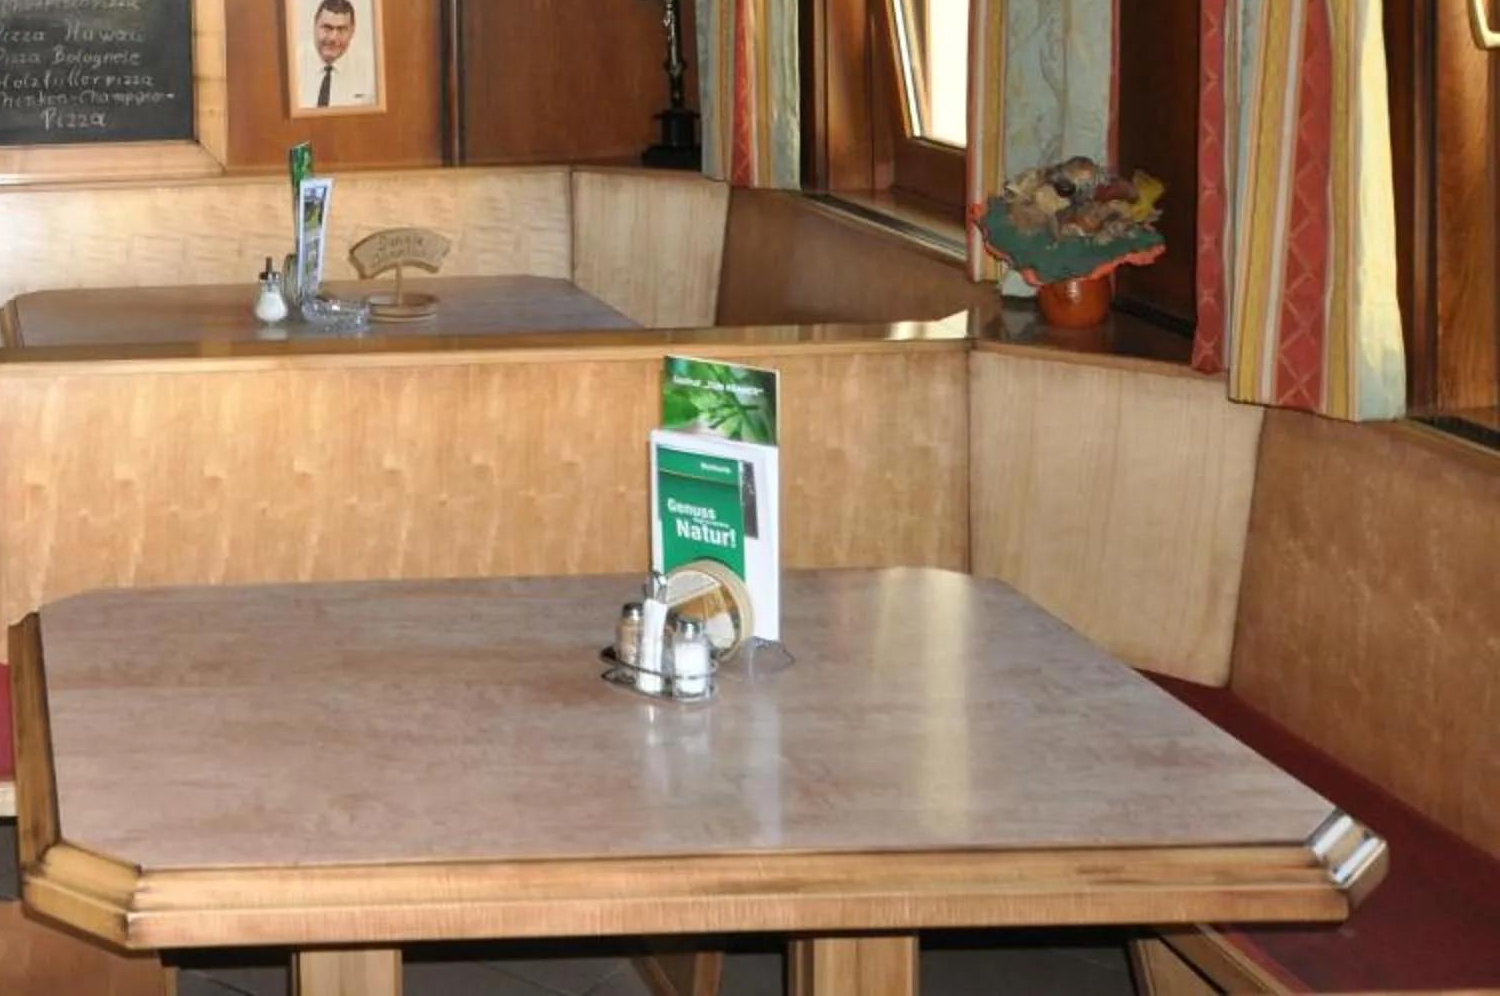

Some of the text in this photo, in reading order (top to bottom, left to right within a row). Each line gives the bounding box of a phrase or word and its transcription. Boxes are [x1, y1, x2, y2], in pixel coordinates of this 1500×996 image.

[41, 107, 107, 131] Pizza
[666, 496, 717, 521] Genuss
[675, 518, 737, 549] Natur!
